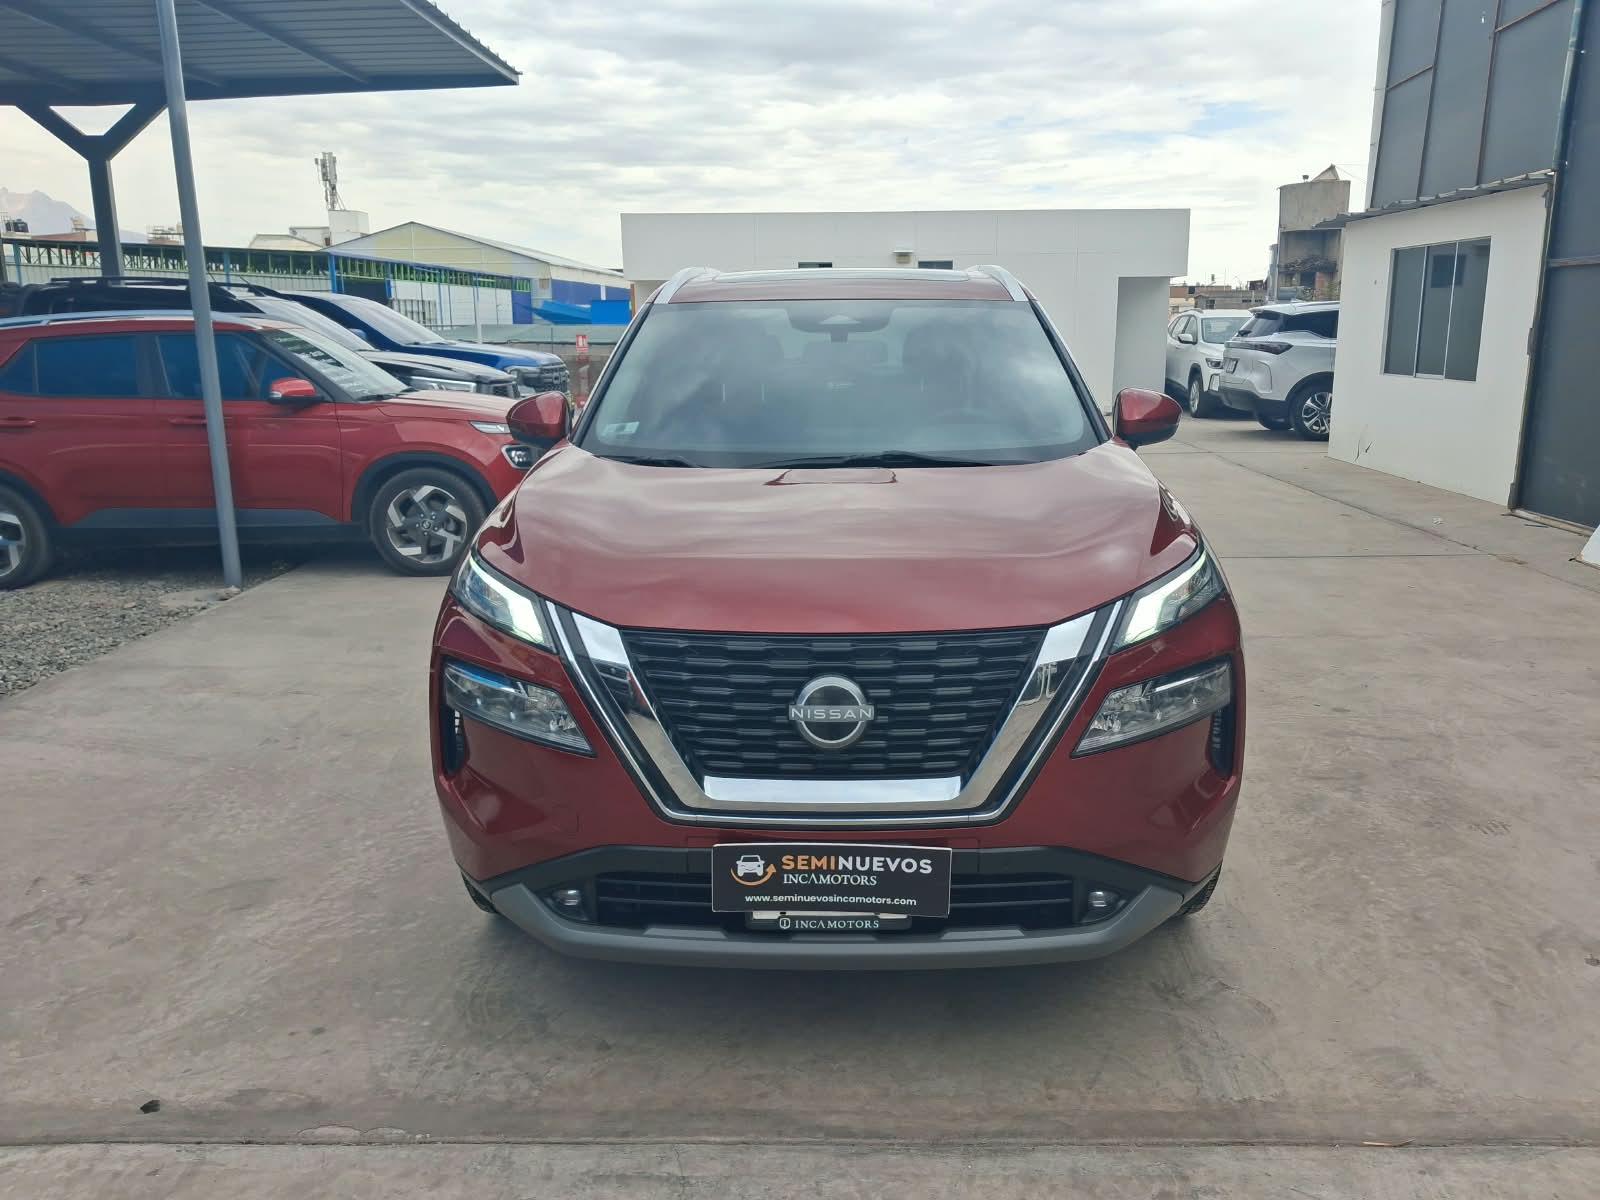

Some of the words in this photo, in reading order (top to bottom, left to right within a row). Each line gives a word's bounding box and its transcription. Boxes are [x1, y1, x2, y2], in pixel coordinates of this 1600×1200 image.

[791, 708, 872, 719] NISSAN
[781, 855, 933, 874] SEMINUEVOS
[783, 874, 877, 886] INCAMOTORS
[745, 893, 917, 906] www.seminuevosincamotors.com
